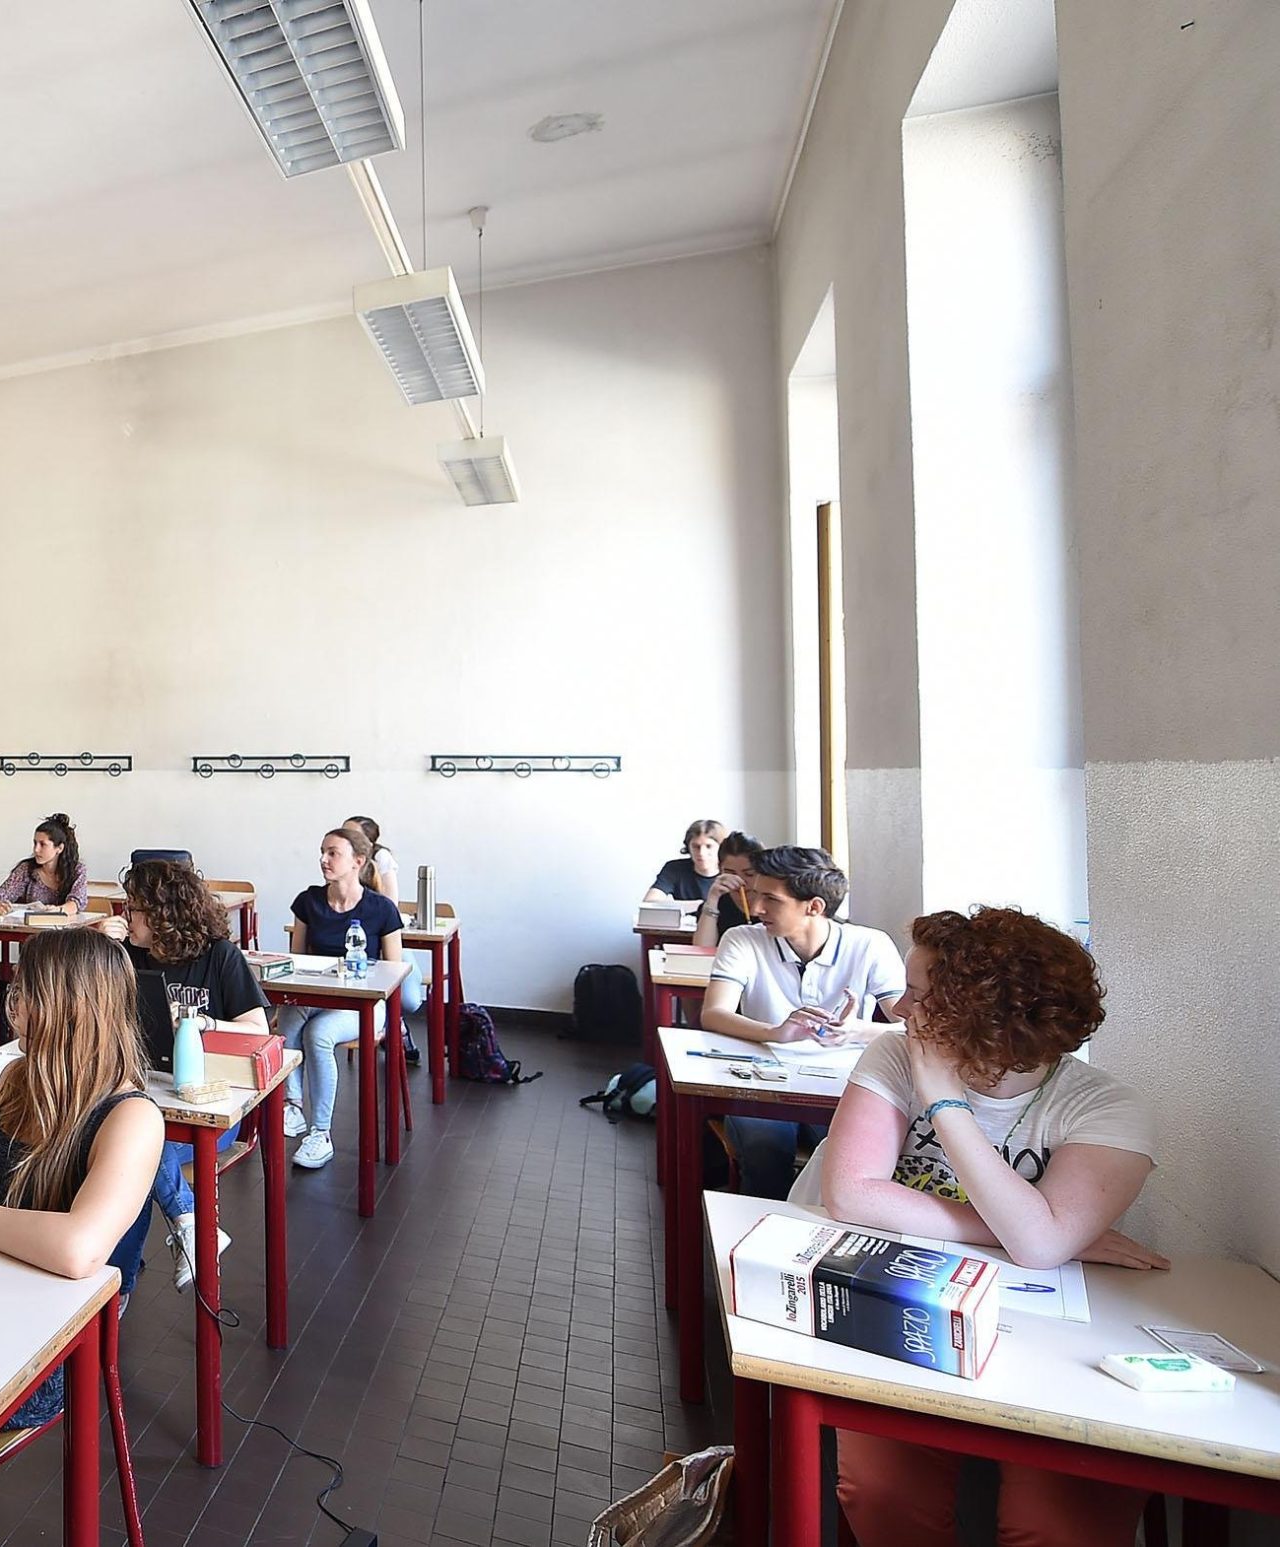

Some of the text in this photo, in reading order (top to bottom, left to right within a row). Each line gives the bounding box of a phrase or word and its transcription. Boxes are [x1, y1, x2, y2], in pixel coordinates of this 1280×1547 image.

[795, 1276, 806, 1295] 2015
[884, 1249, 947, 1288] SPAZIO
[903, 1307, 936, 1363] SPAZIO
